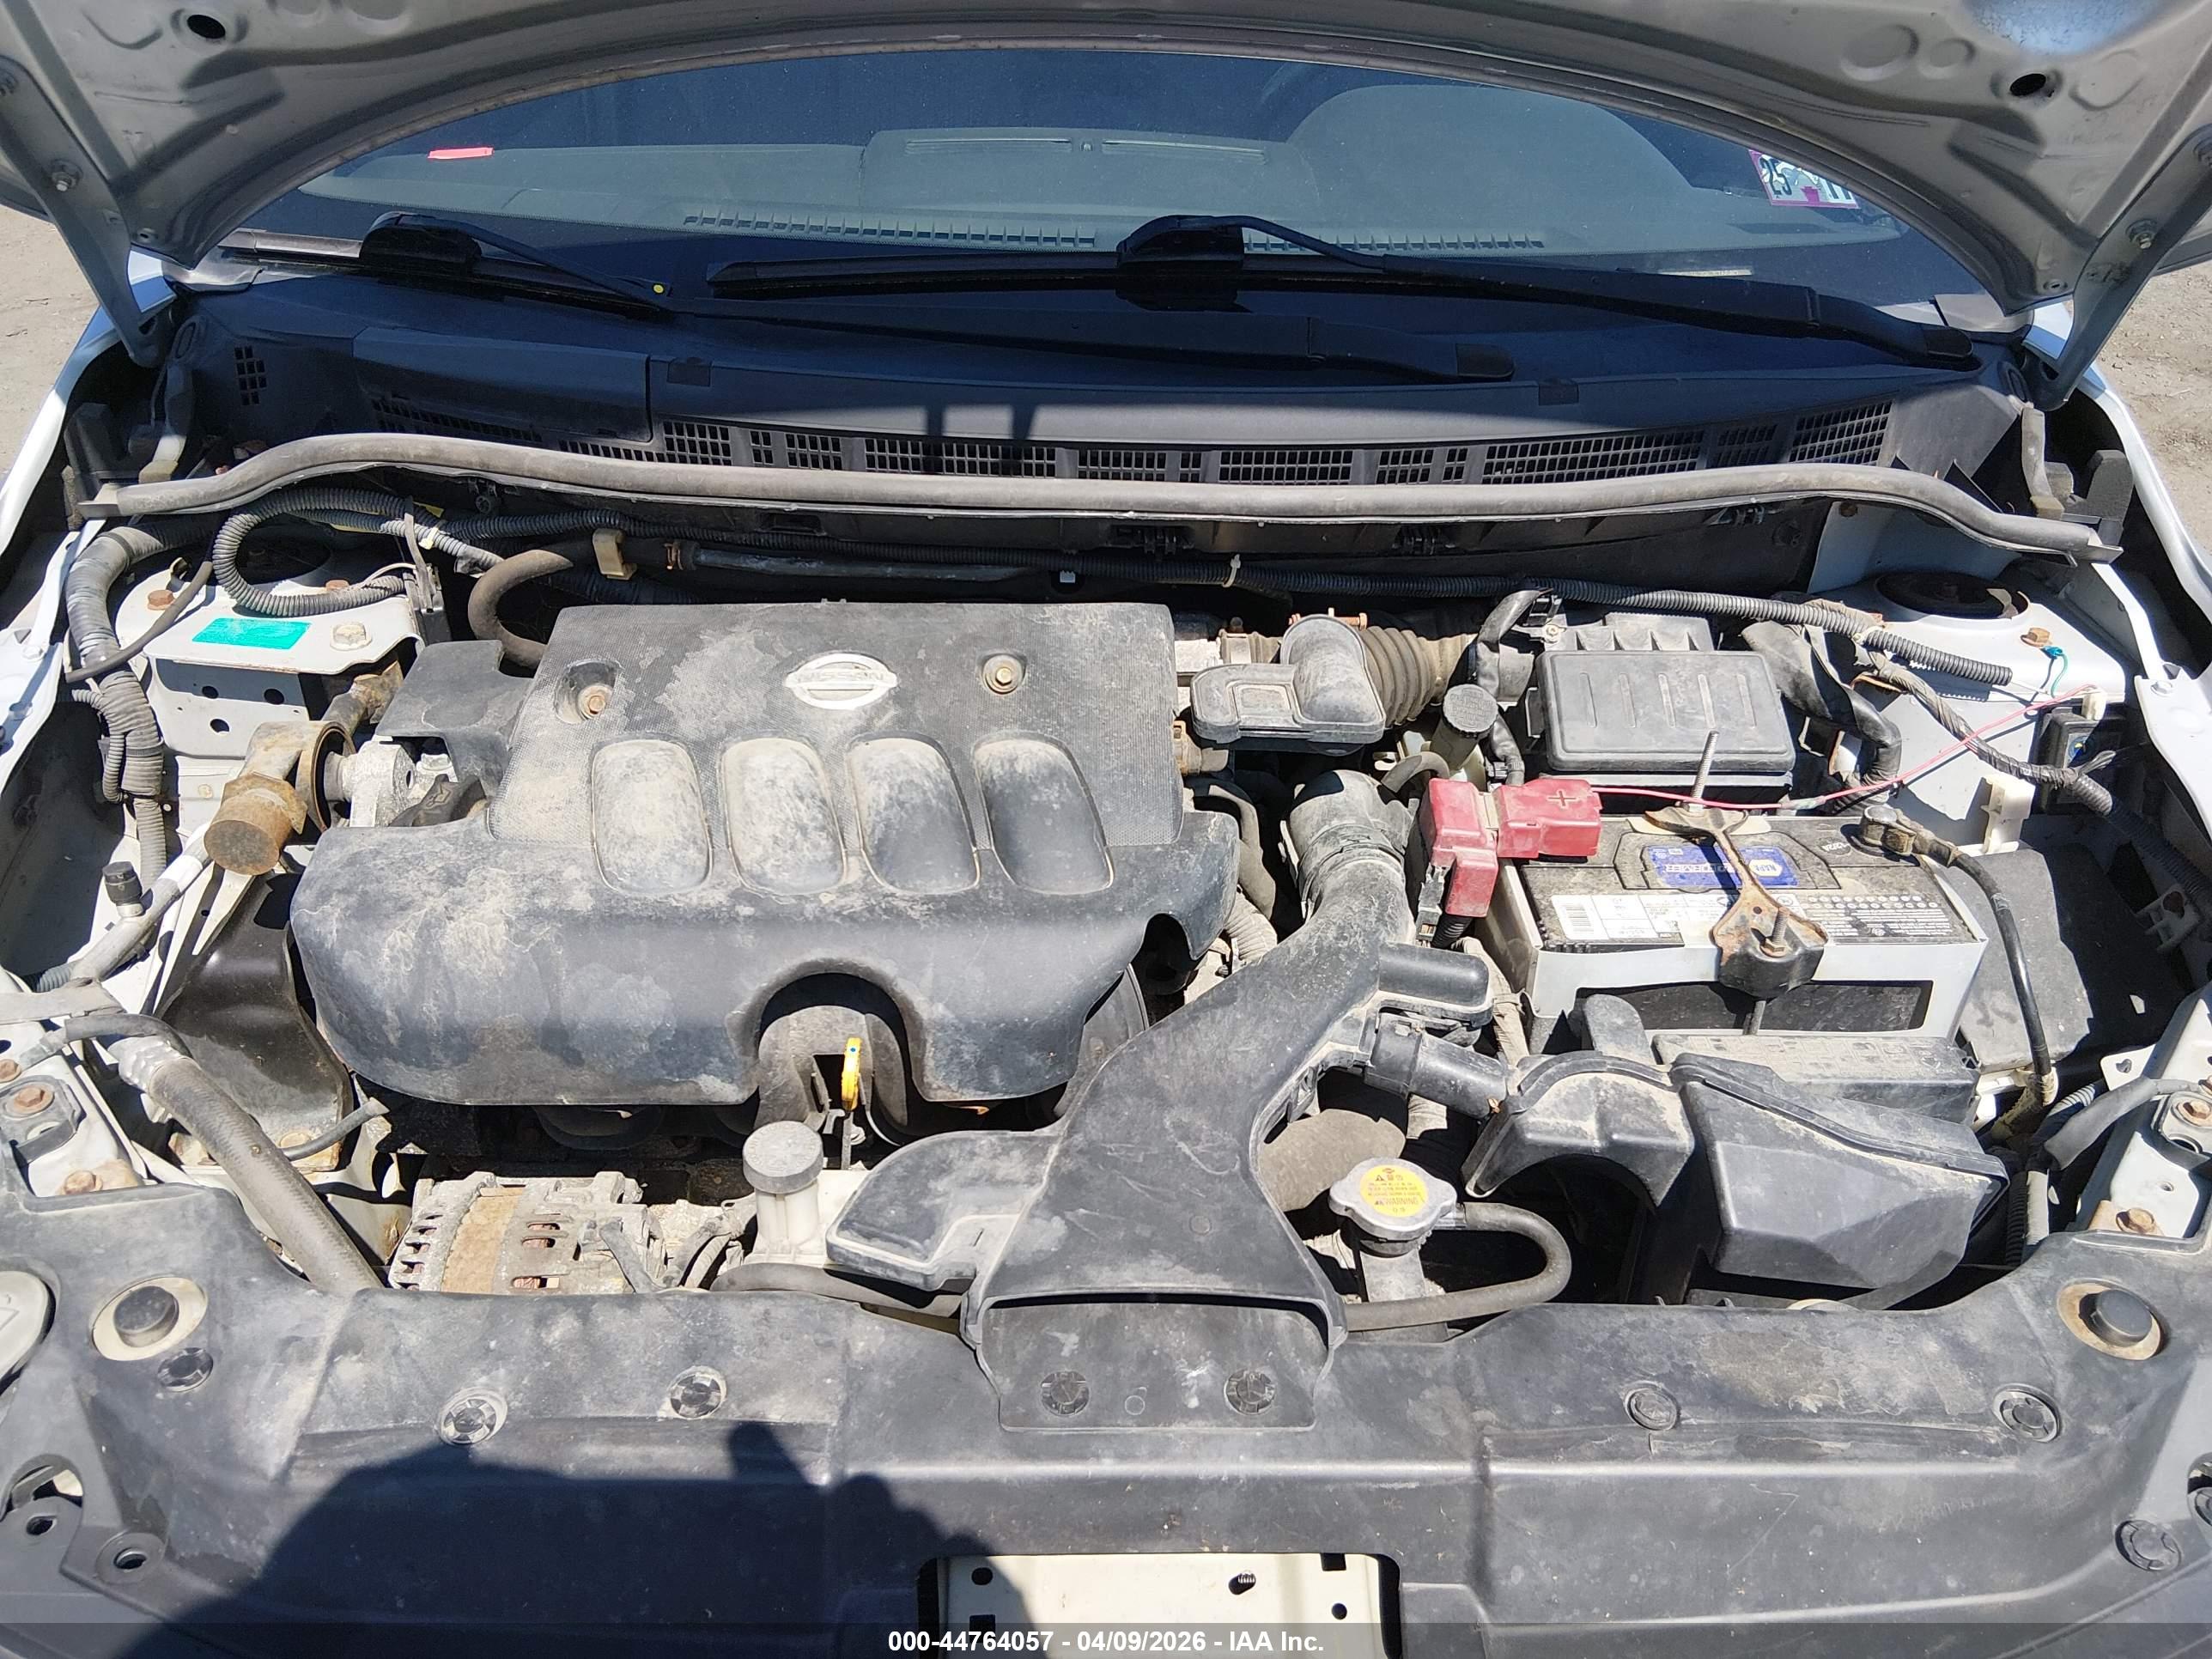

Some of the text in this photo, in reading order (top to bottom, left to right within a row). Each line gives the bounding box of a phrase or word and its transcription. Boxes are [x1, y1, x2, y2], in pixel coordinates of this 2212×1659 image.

[1759, 157, 1793, 196] 25
[797, 672, 884, 684] NISSAN
[1753, 863, 1777, 872] NAPA
